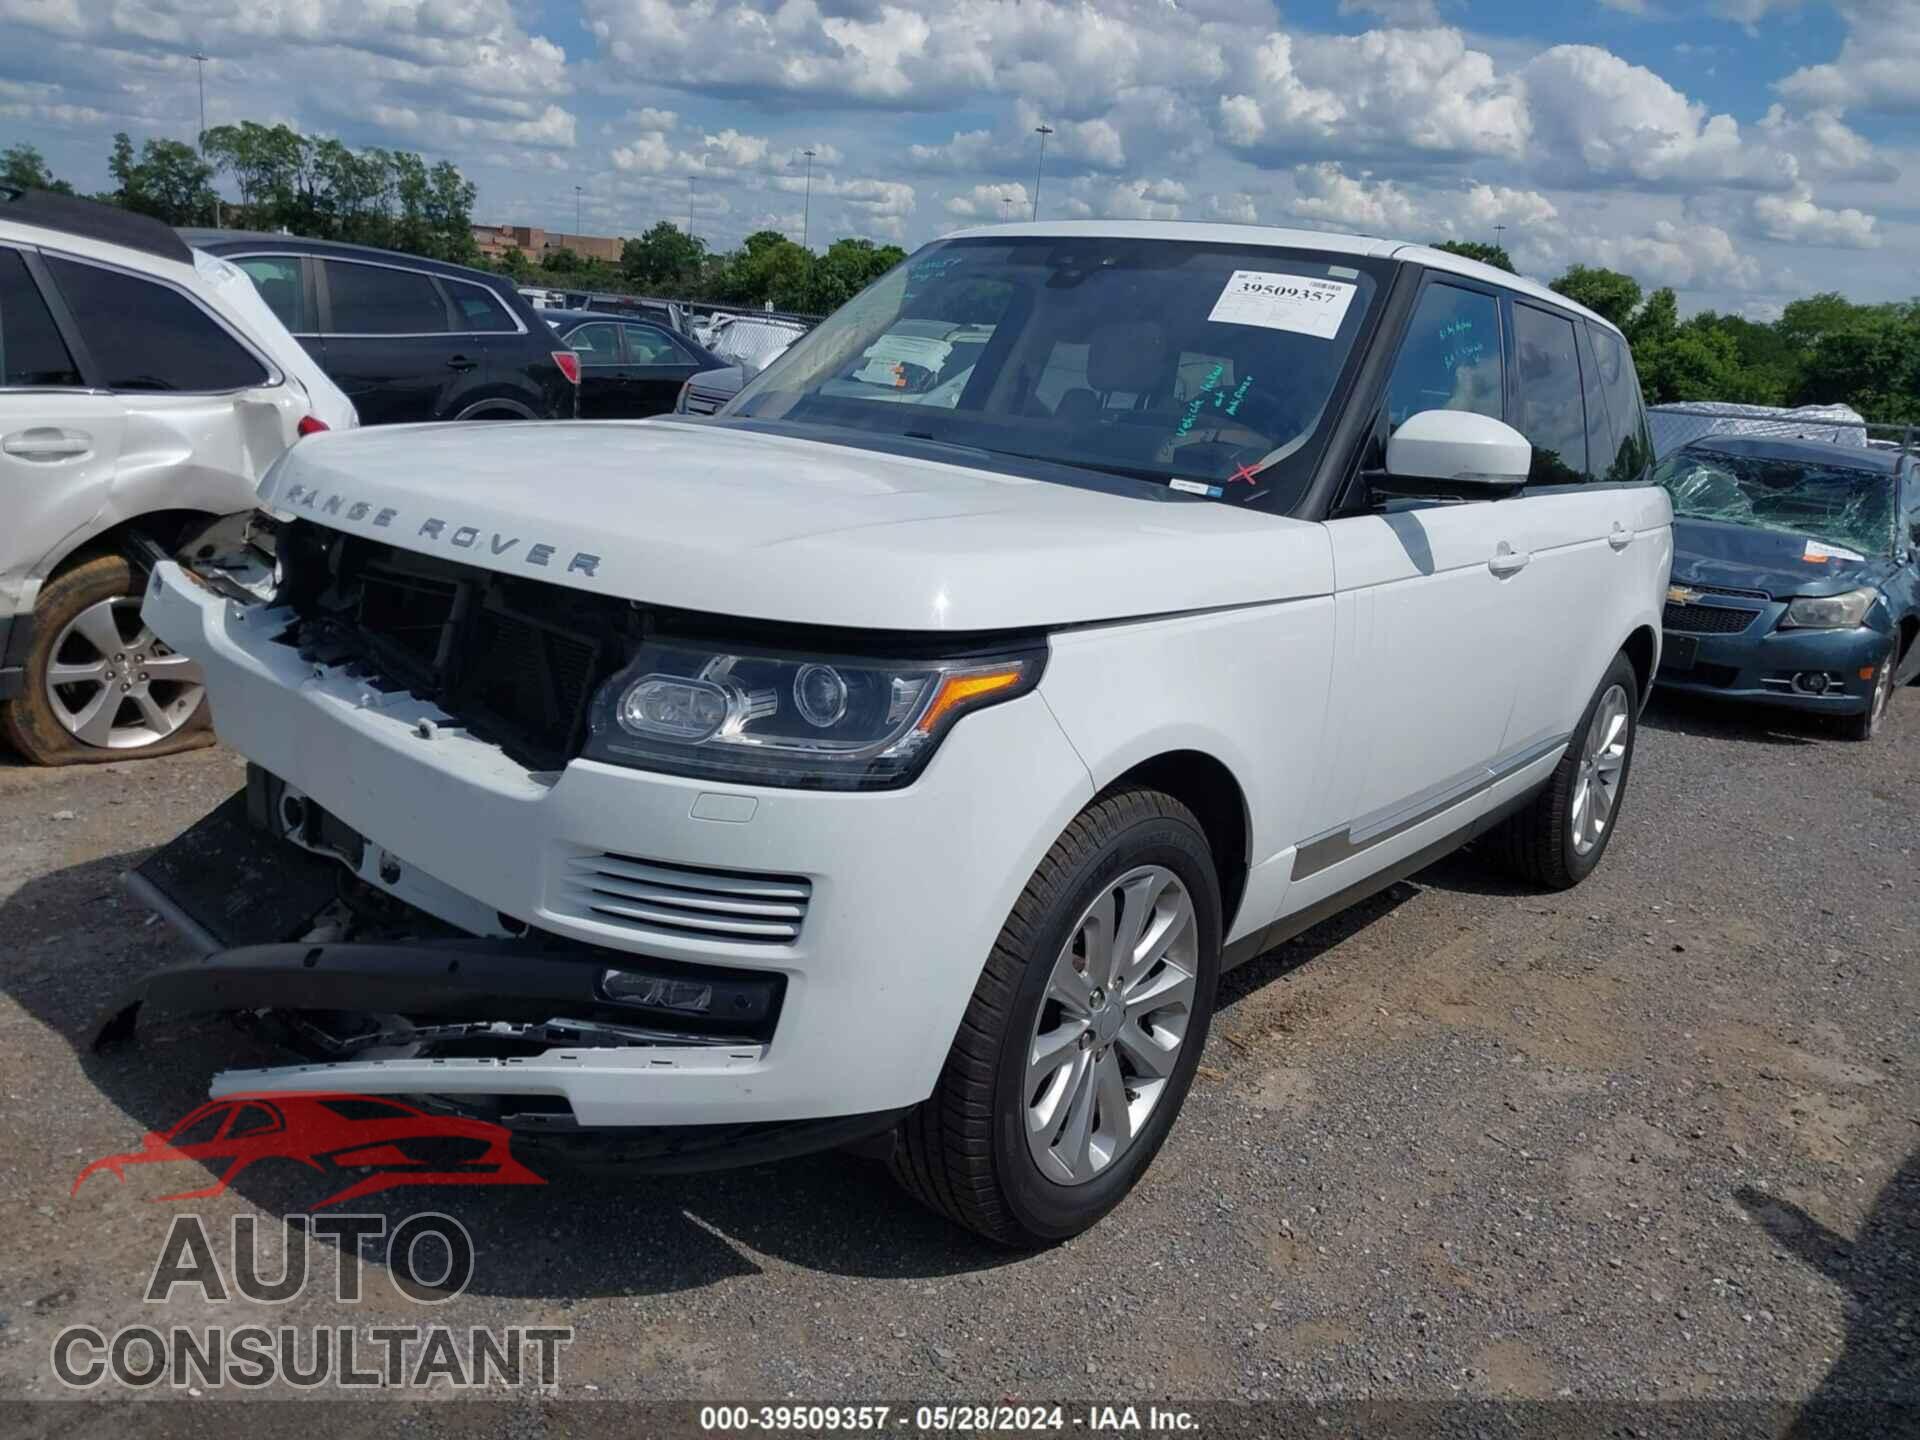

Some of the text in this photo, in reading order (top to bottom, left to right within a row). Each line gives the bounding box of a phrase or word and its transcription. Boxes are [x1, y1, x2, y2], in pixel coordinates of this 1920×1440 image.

[1236, 282, 1337, 304] 39509357
[286, 484, 602, 577] RANGE ROVER
